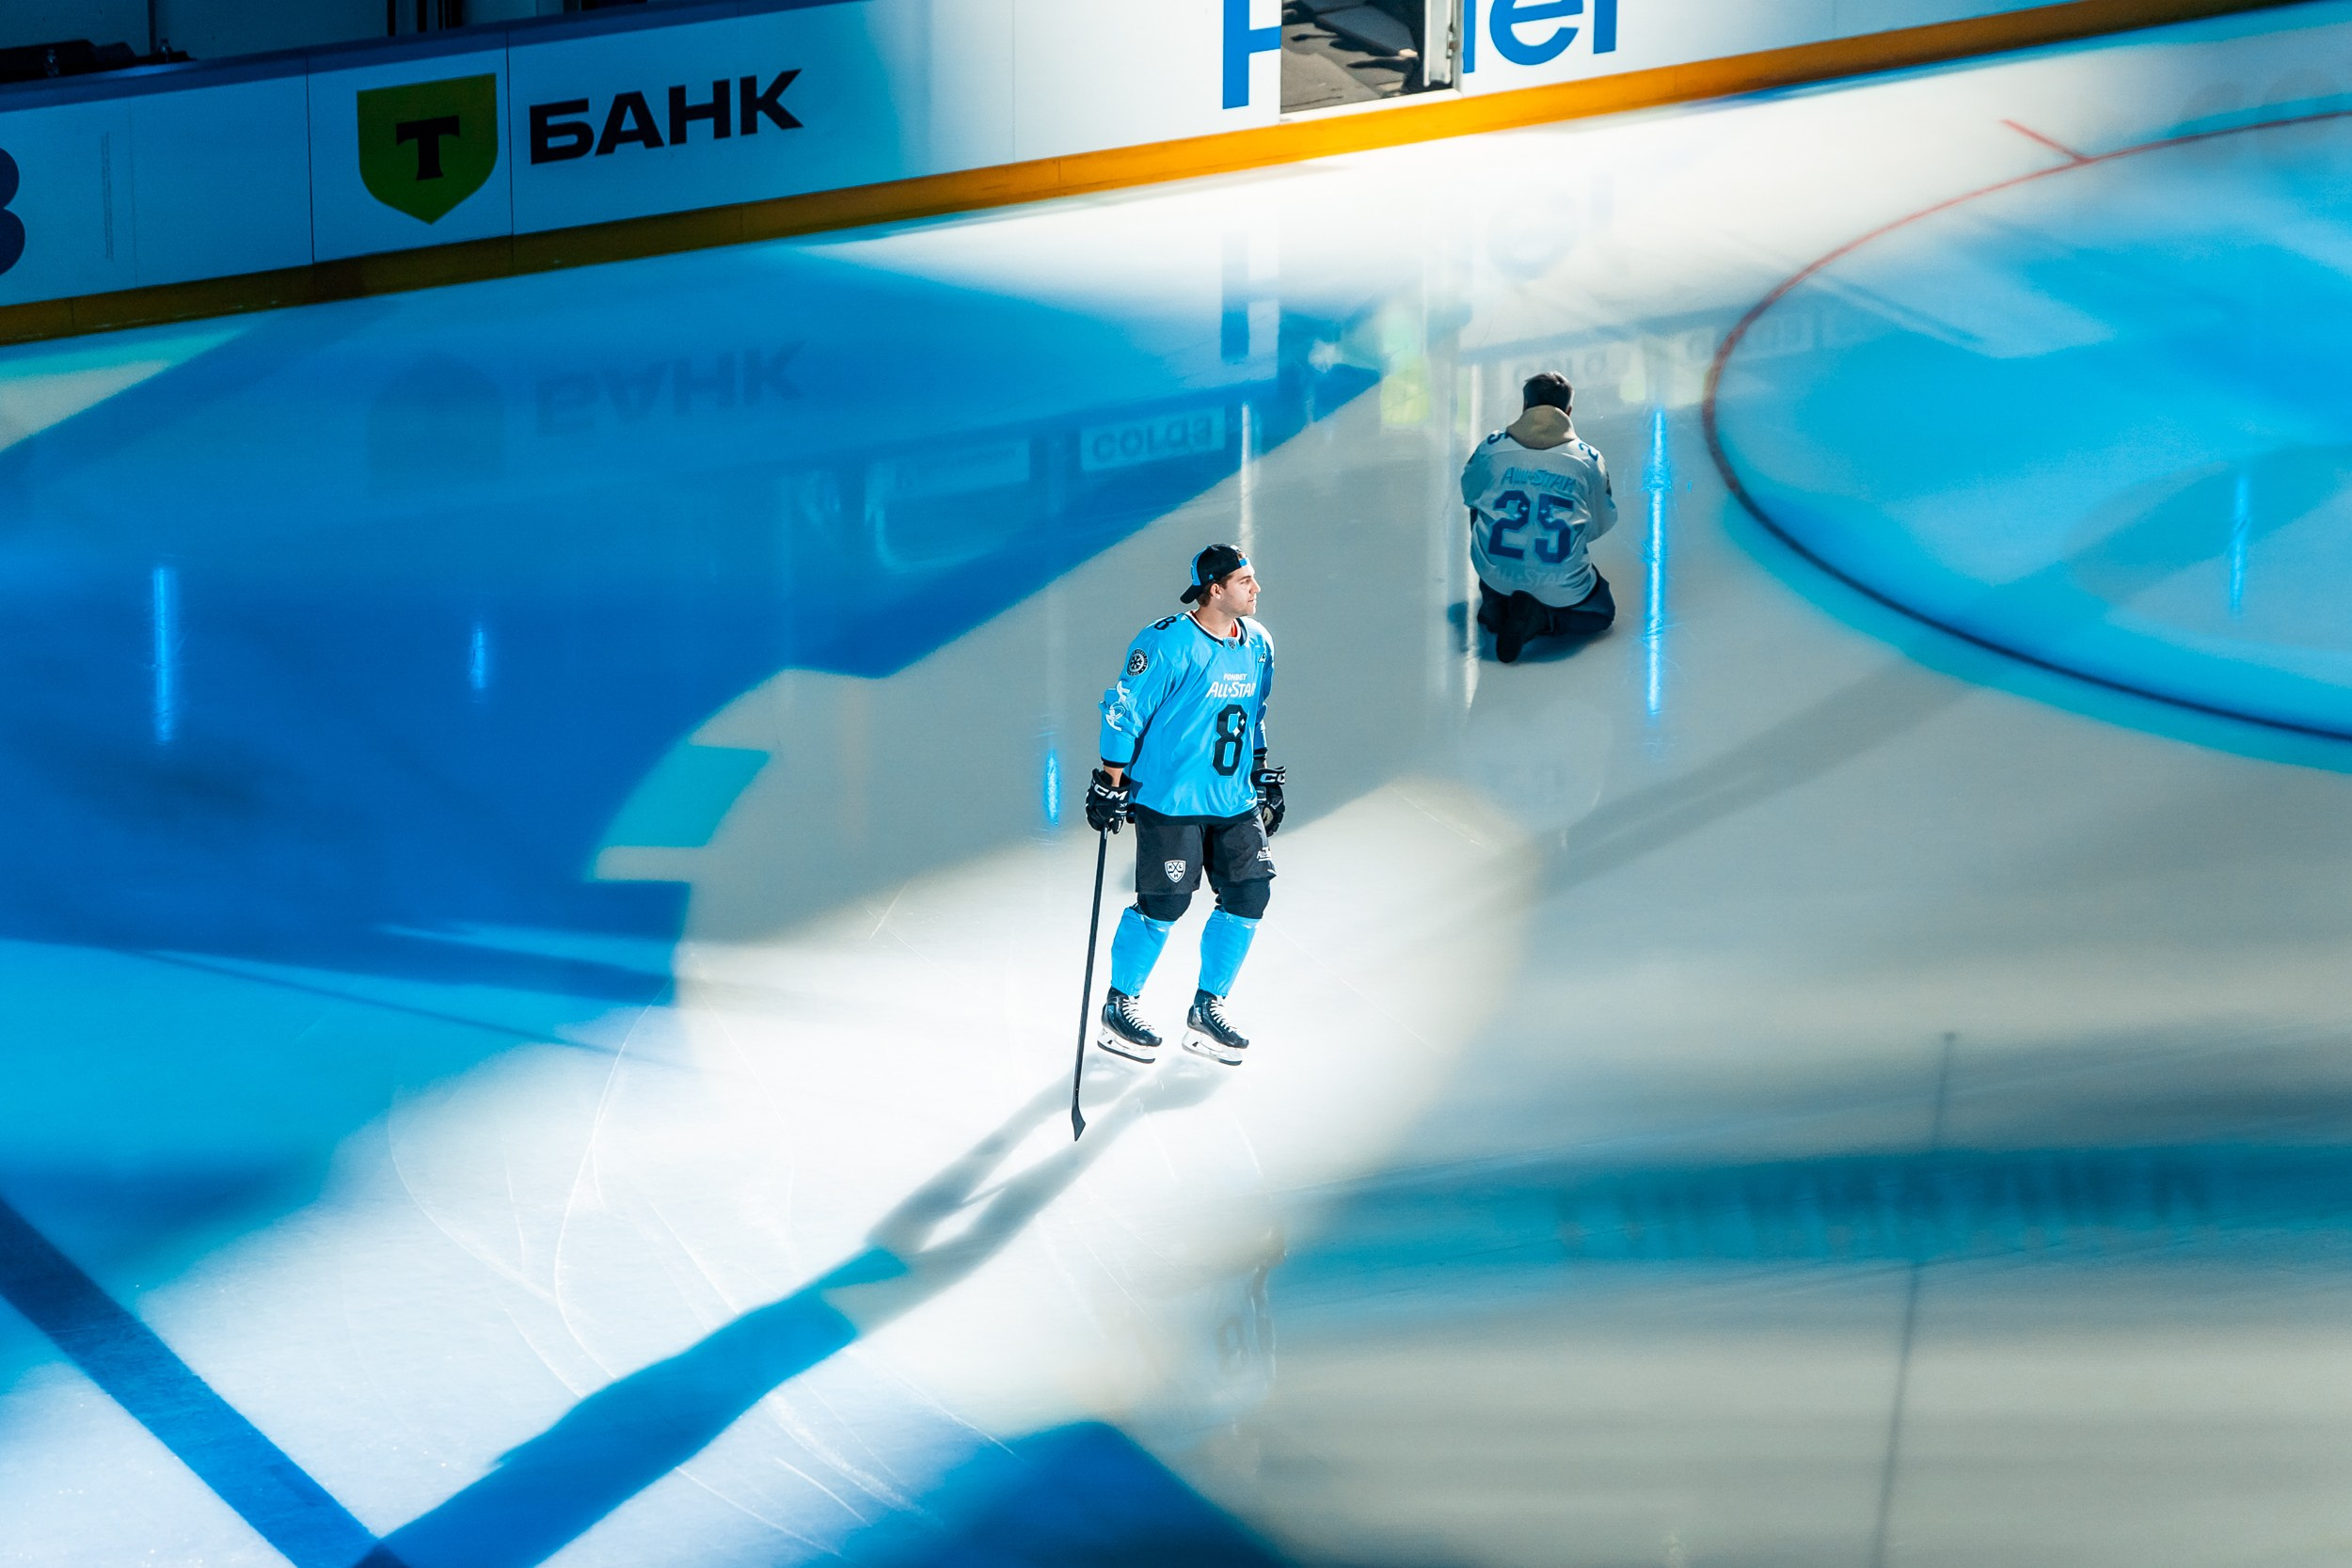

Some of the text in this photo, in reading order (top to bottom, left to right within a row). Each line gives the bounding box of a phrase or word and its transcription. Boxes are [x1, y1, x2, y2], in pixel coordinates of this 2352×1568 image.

[529, 68, 804, 165] БАНК
[1488, 490, 1575, 564] 25
[1223, 673, 1248, 681] FONBET
[1212, 704, 1248, 777] 8
[1092, 780, 1128, 800] CM
